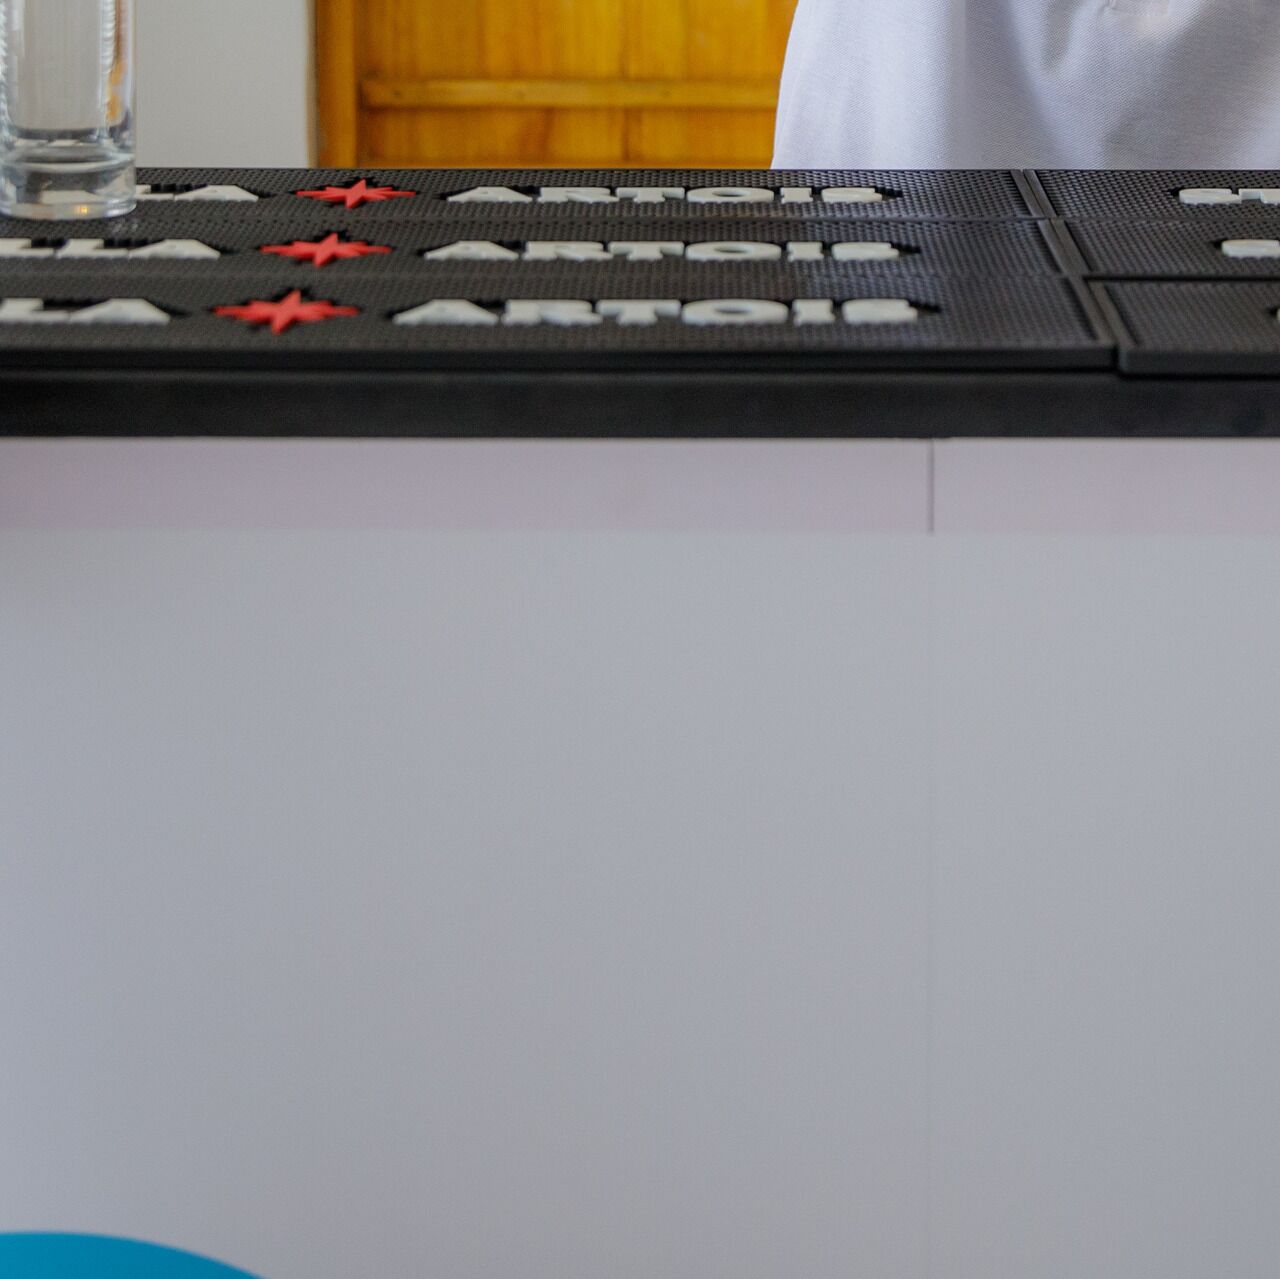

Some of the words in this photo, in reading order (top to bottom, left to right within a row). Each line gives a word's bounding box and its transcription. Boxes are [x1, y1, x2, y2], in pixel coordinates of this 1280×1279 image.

[446, 185, 883, 204] ARTOIS
[423, 240, 901, 262] ARTOIS
[391, 298, 919, 326] ARTOIS
